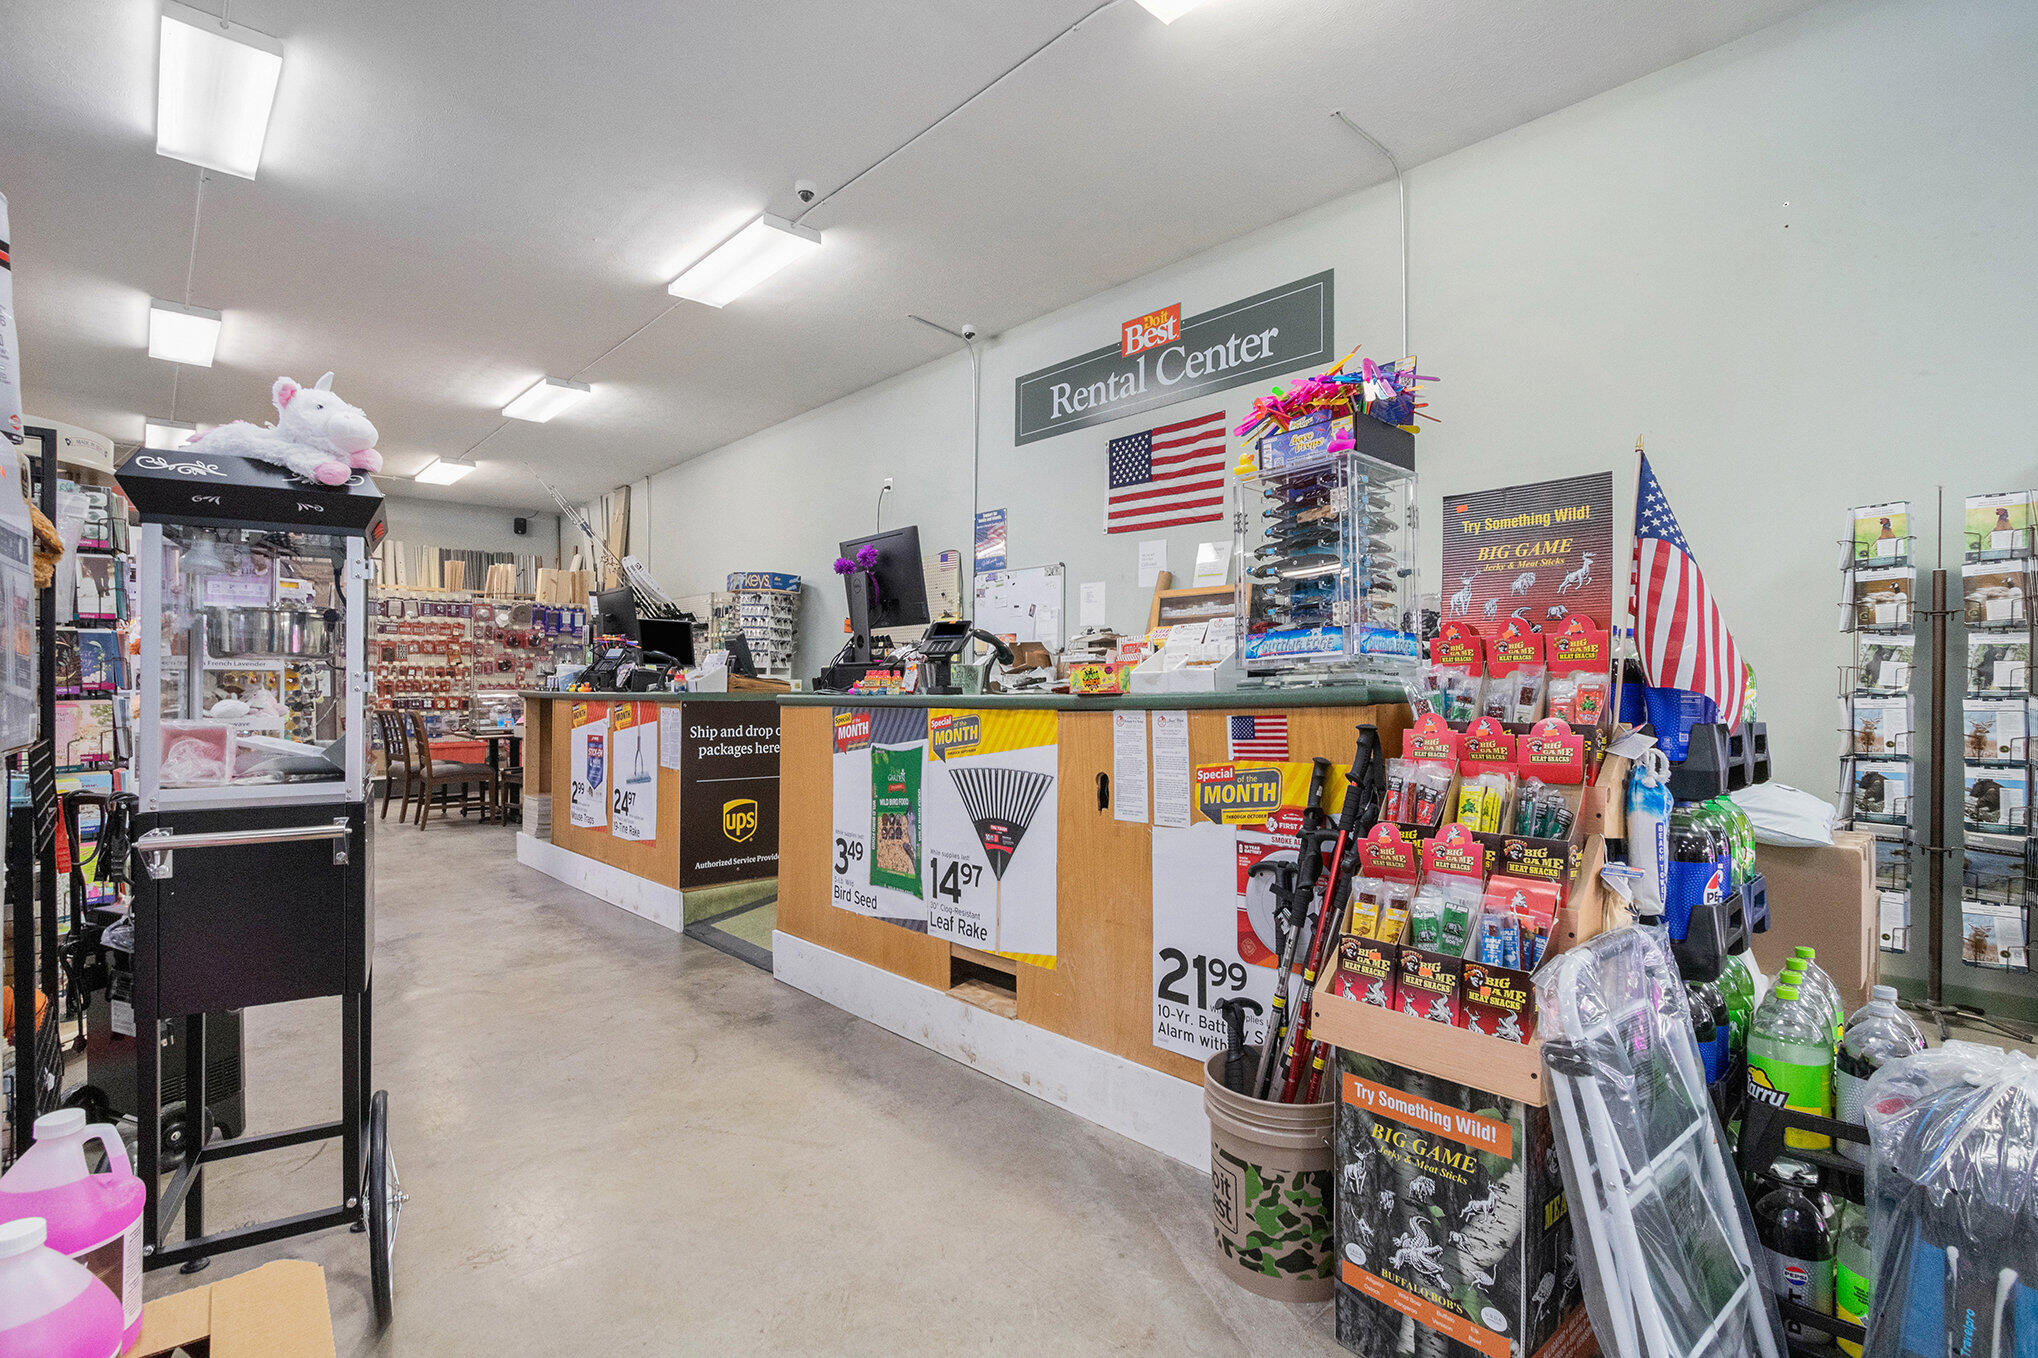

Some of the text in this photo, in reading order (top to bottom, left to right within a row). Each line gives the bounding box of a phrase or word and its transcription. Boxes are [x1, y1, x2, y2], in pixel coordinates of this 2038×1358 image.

[1144, 311, 1168, 330] Do it
[1124, 316, 1179, 355] Best
[1050, 327, 1279, 420] Rental Center
[1462, 505, 1590, 535] Try Something Wild!
[1477, 538, 1573, 562] BIG GAME
[1483, 557, 1565, 572] Jerky & Meat Sticks
[1450, 643, 1464, 651] BIG
[1508, 641, 1524, 649] BIG
[1570, 639, 1587, 647] BIG
[1570, 644, 1598, 652] GAME
[1508, 647, 1535, 655] GAME
[616, 711, 632, 721] MONTH
[835, 715, 850, 724] Special
[931, 716, 951, 728] Special
[690, 725, 773, 740] Ship and drop
[838, 721, 869, 740] MONTH
[935, 724, 978, 745] MONTH
[698, 742, 780, 759] packages here
[1480, 740, 1496, 748] BIG
[1480, 746, 1508, 755] GAME
[1542, 747, 1573, 756] GAME
[1543, 741, 1562, 749] BIG
[1197, 767, 1233, 781] Special
[1204, 782, 1276, 804] MONTH
[614, 788, 636, 816] 2497
[629, 825, 640, 837] Rake
[726, 812, 755, 835] ups
[1271, 836, 1292, 845] SMOKE
[834, 838, 863, 874] 349
[942, 851, 960, 859] supplies
[1380, 847, 1395, 855] BIG
[1380, 854, 1406, 863] GAME
[1523, 848, 1548, 858] BIG
[695, 849, 779, 870] Authorized Service Provid
[1435, 860, 1450, 868] MEAT
[1445, 855, 1474, 865] GAME
[1523, 857, 1564, 869] GAME
[1509, 864, 1558, 877] MEAT SNACKS
[930, 857, 983, 904] 1497
[834, 885, 877, 909] Bird Seed
[940, 904, 981, 920] Clog-Resistant
[930, 911, 987, 941] Leaf Rake
[1344, 961, 1386, 977] MEAT SNACKS
[1357, 956, 1391, 971] GAME
[1419, 962, 1441, 972] BIG
[1158, 947, 1248, 1011] 2199
[1405, 975, 1450, 992] MEAT SNACKS
[1428, 974, 1456, 986] AME
[1485, 977, 1510, 988] BIG
[1469, 991, 1521, 1010] MEAT SNACKS
[1491, 987, 1527, 1003] AME
[1158, 1004, 1193, 1025] 10-Yr.
[1246, 1015, 1264, 1026] plies
[1158, 1022, 1227, 1051] Alarm with
[1354, 1081, 1497, 1144] Try Something Wild!
[1371, 1122, 1478, 1174] BIG GAME
[1378, 1144, 1469, 1186] Jerky & Meat Sticks
[1221, 1173, 1231, 1200] it
[1213, 1193, 1232, 1224] est
[1544, 1190, 1568, 1230] MEA
[1784, 1271, 1807, 1280] PEPSI
[1393, 1300, 1418, 1315] Kangaroo
[1960, 1308, 1975, 1357] Travelpro
